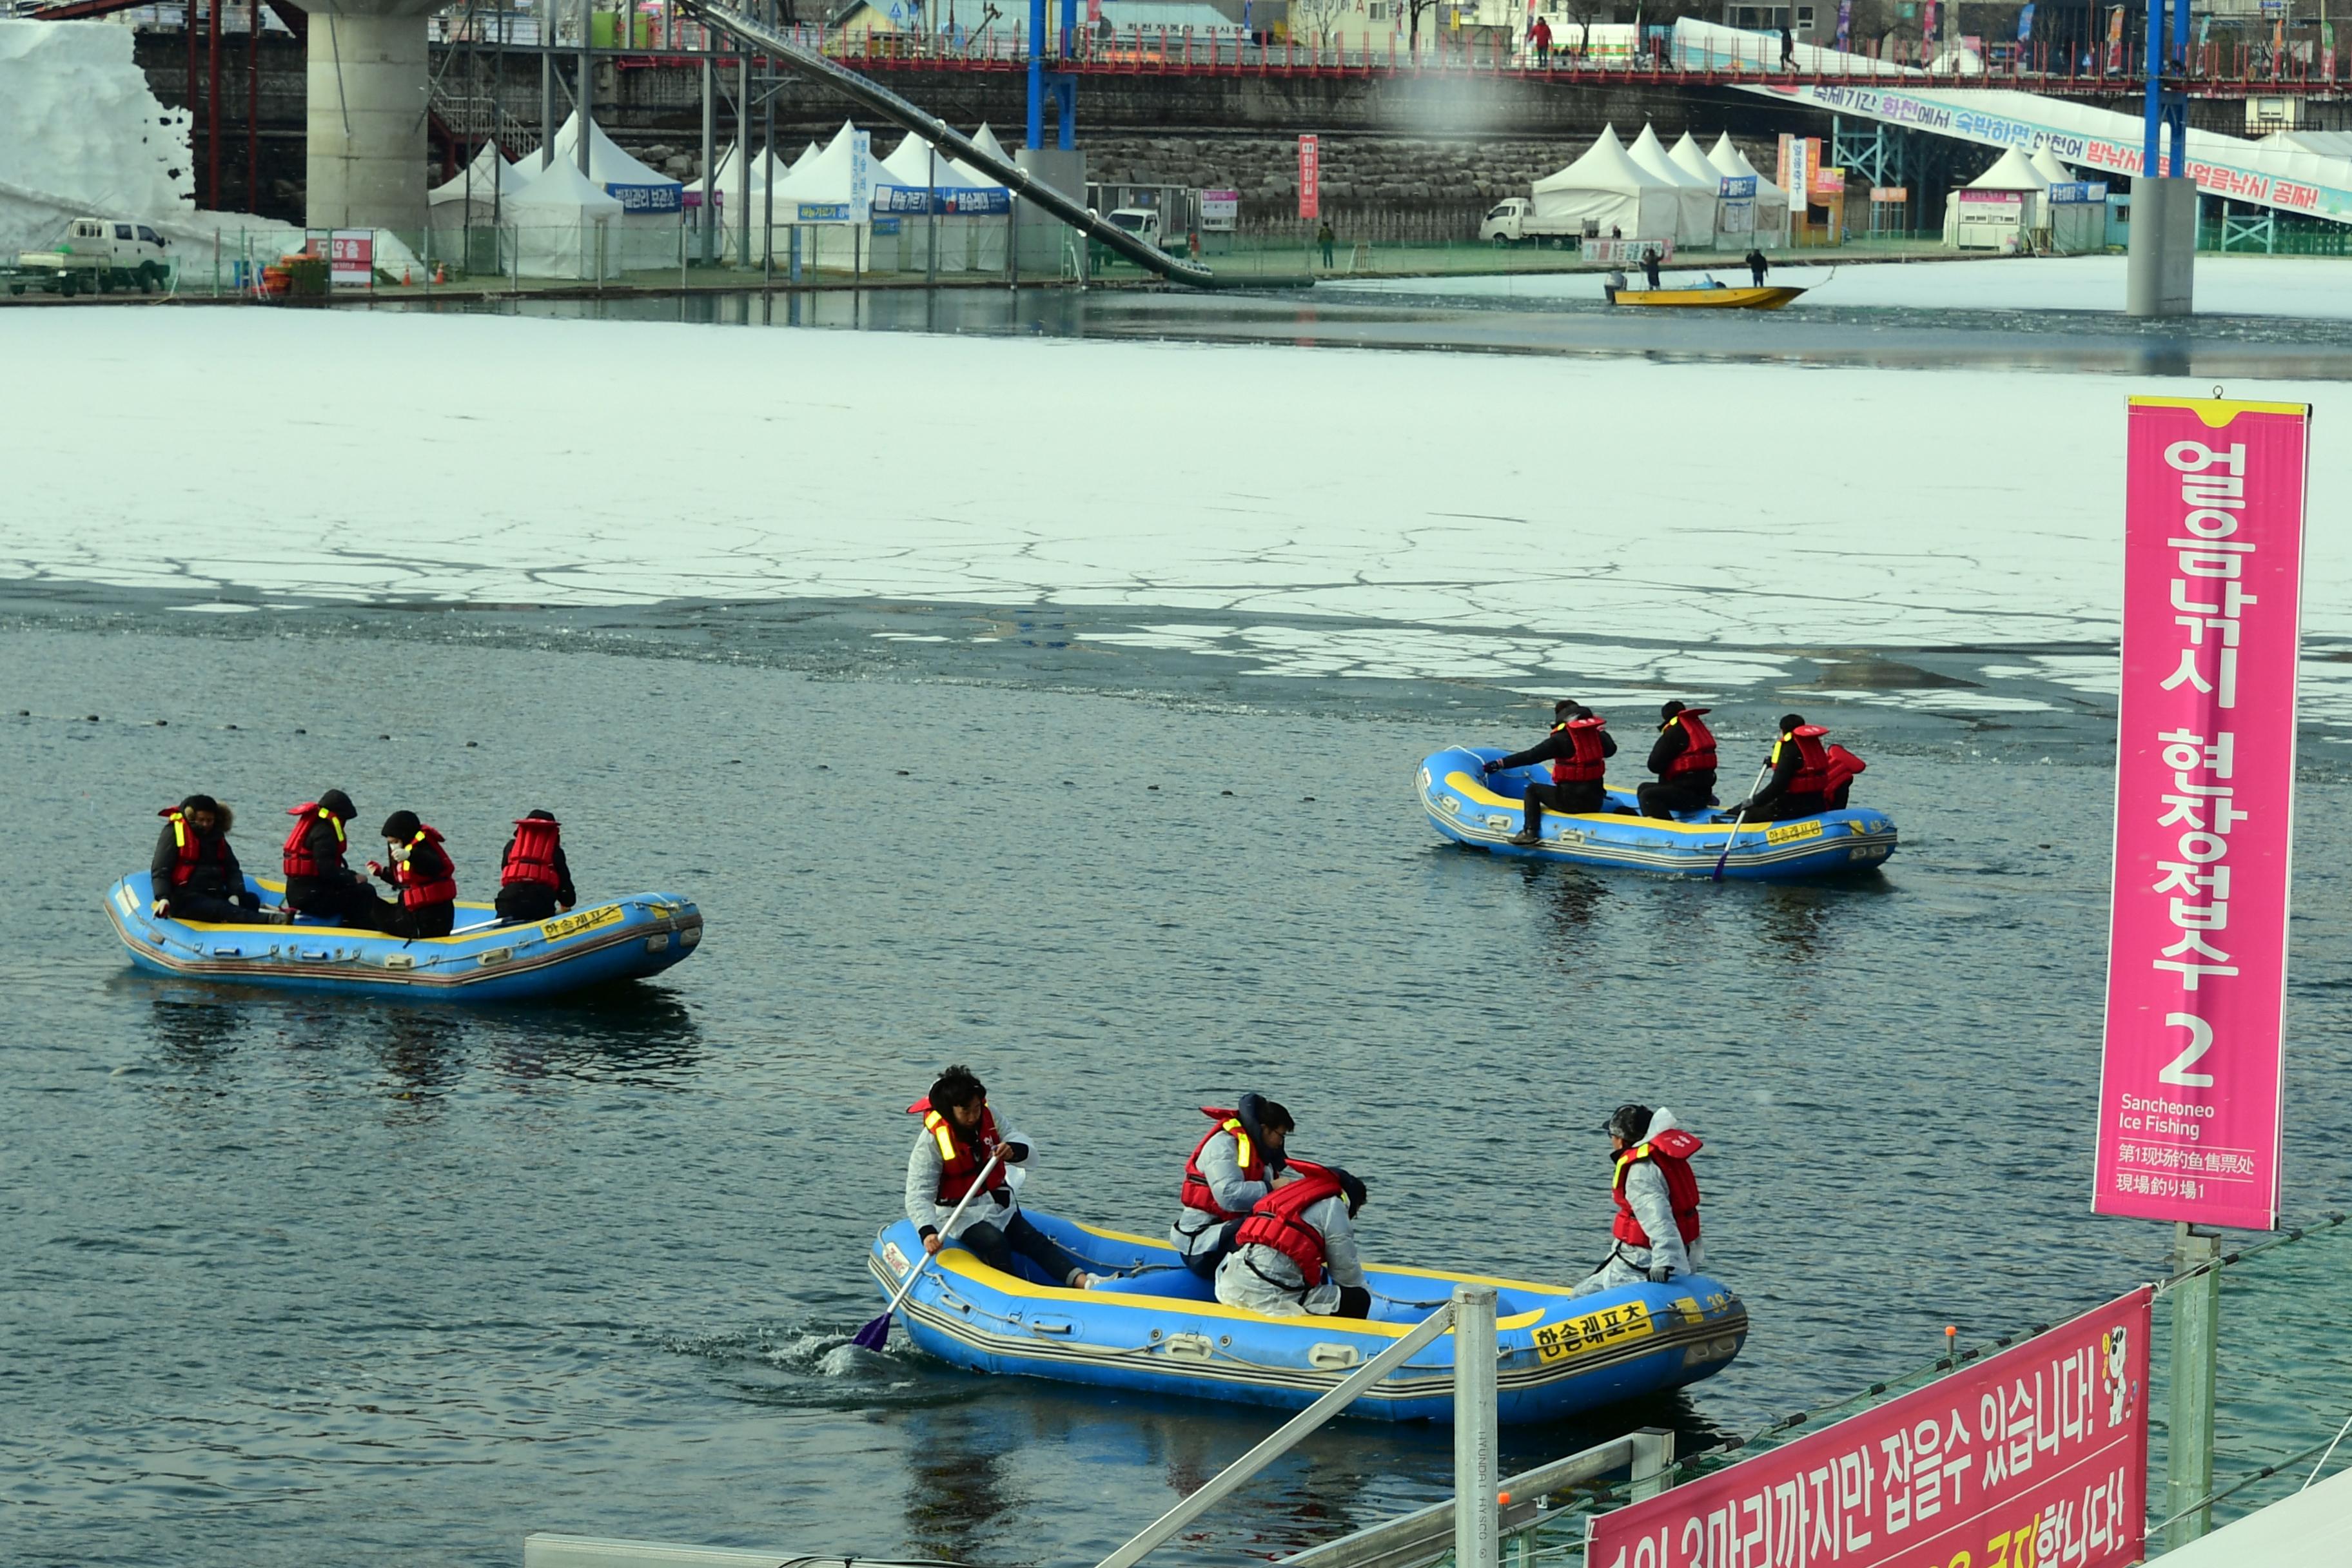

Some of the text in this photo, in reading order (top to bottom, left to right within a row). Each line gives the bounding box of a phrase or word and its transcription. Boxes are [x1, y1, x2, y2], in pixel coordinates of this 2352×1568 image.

[1882, 95, 1951, 130] 화천에서
[1956, 112, 2031, 147] 숙박하면
[2272, 181, 2320, 210] 공짜!
[2160, 440, 2258, 709] 얼음낚시
[2152, 727, 2248, 991] 현장접수
[2159, 1012, 2214, 1088] 2
[2119, 1113, 2200, 1141] Ice Fishing
[2121, 1093, 2215, 1119] Sancheoneo
[2115, 1173, 2204, 1200] 現場釣り場1
[2118, 1143, 2255, 1175] 第1现场钓鱼售票处
[1478, 1431, 1487, 1488] HYUNDAI
[1880, 1408, 1972, 1534] 잡을수
[1980, 1346, 2094, 1491] 있습니다!
